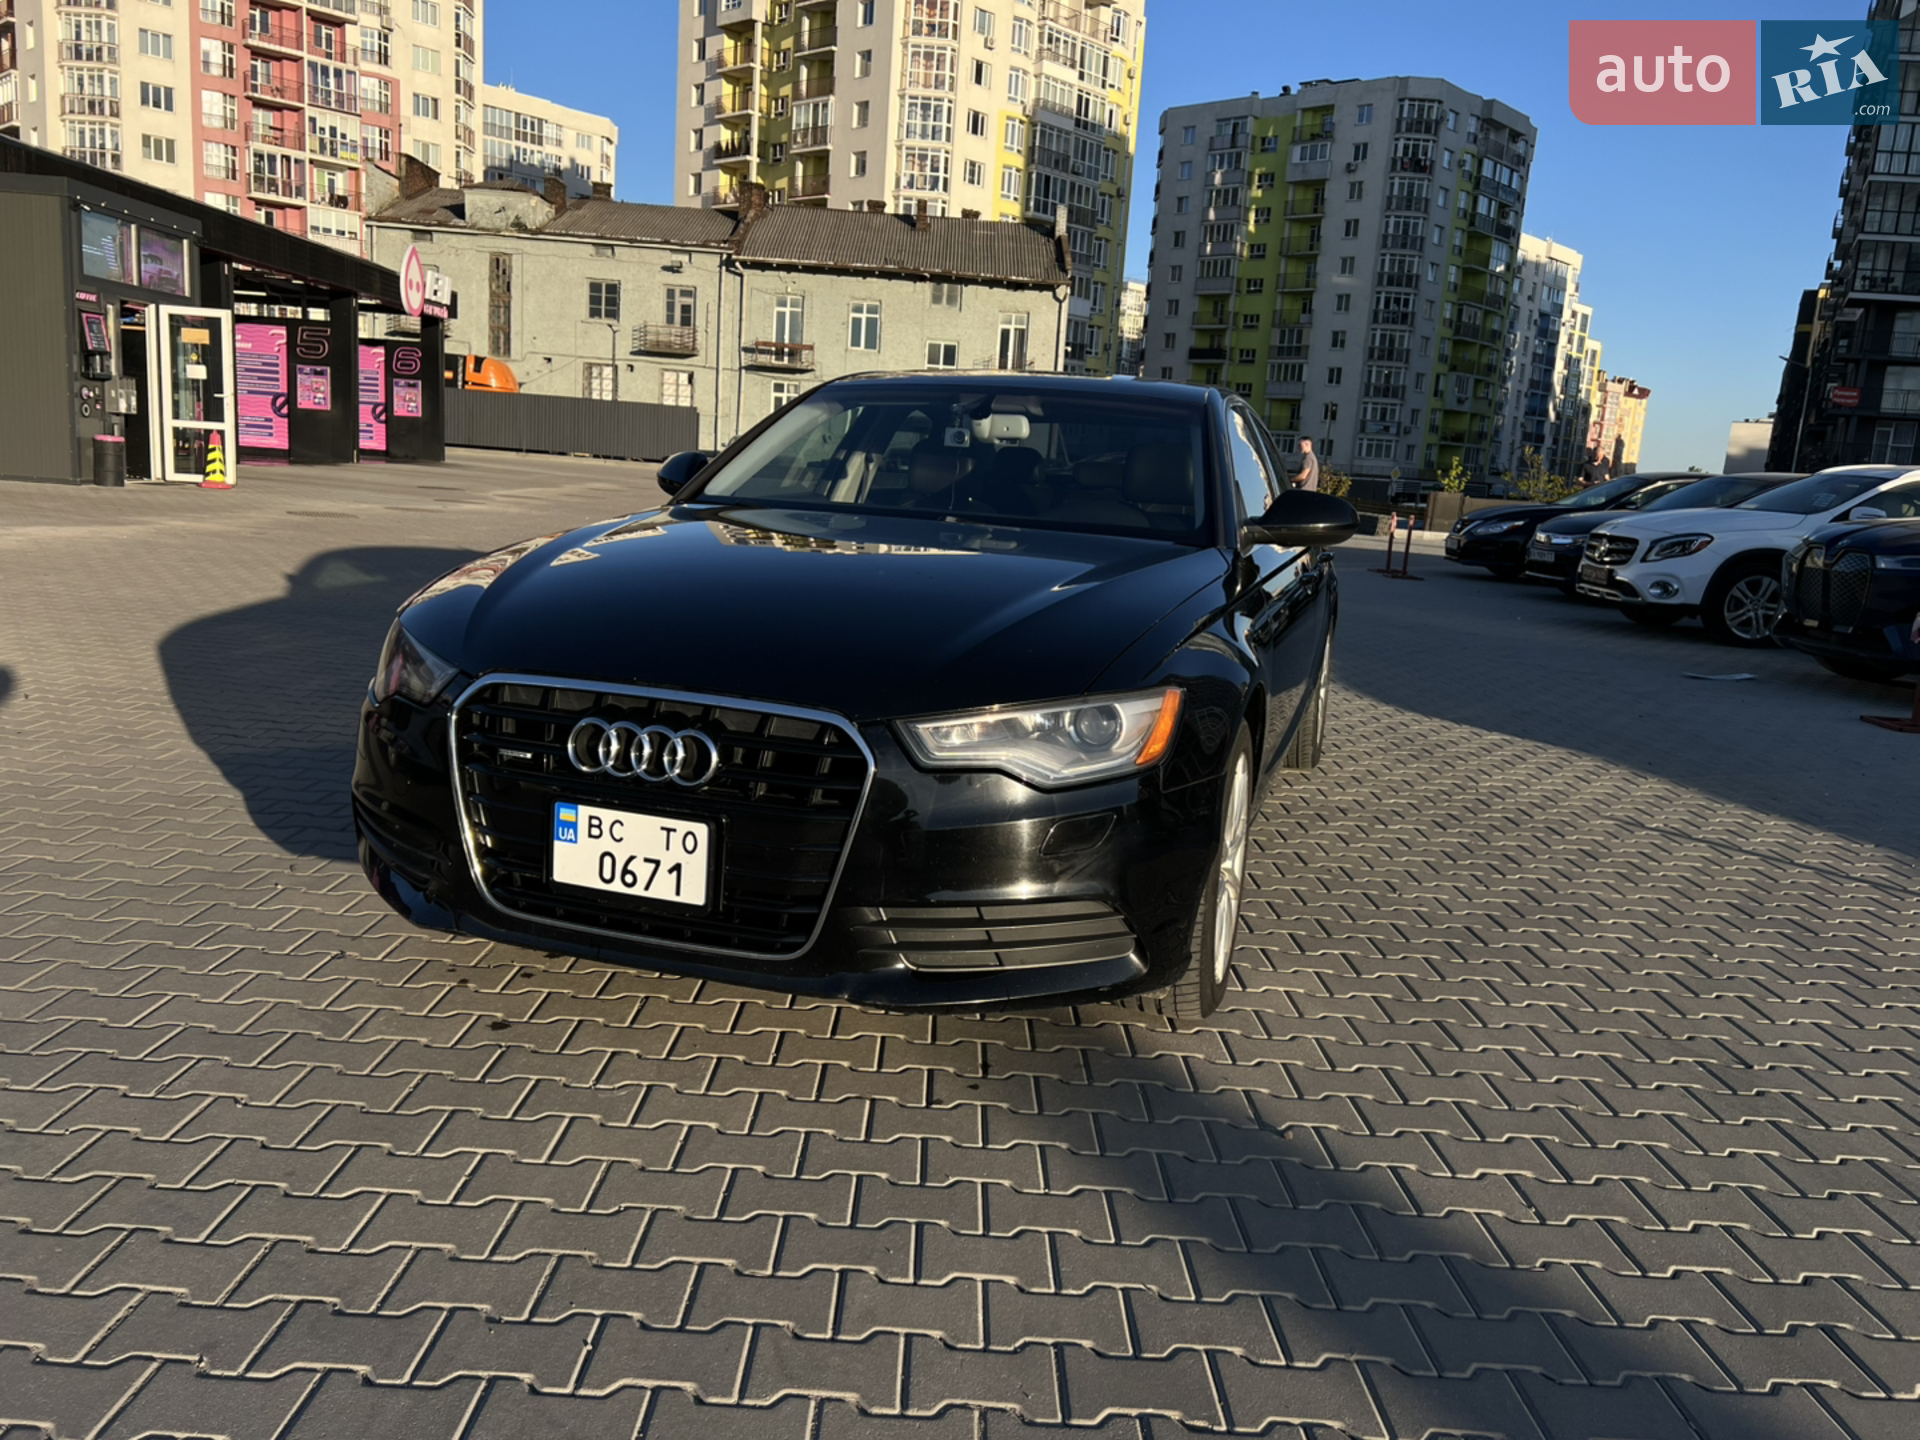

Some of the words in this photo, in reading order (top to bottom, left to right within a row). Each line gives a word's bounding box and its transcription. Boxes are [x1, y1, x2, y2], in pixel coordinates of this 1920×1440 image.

[296, 325, 331, 359] 5
[392, 346, 422, 376] 6
[558, 826, 576, 842] UA
[587, 814, 624, 843] BC
[598, 850, 682, 897] 0671
